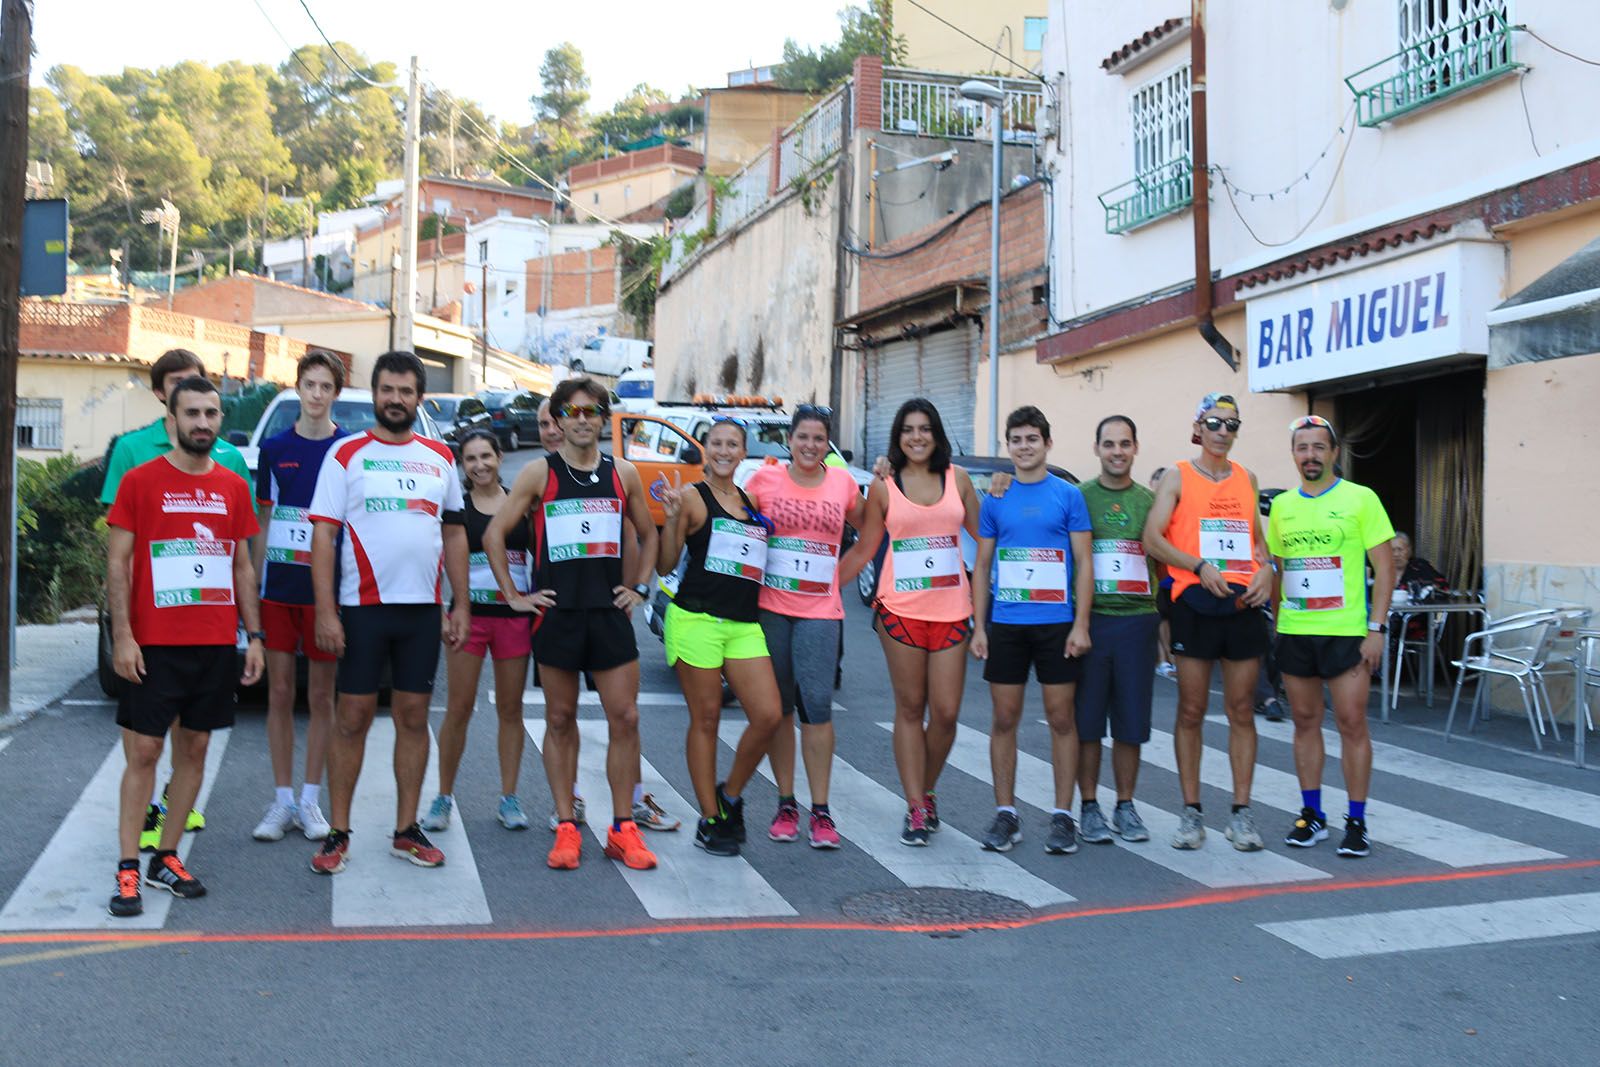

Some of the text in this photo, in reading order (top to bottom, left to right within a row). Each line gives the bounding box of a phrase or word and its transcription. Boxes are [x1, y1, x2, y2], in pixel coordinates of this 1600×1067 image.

[1258, 272, 1448, 368] BAR MIGUEL
[397, 478, 415, 491] 10
[581, 520, 590, 534] 8
[289, 529, 306, 542] 13
[740, 543, 749, 556] 5
[1218, 539, 1234, 551] 14
[795, 559, 809, 573] 11
[925, 556, 934, 568] 6
[1112, 560, 1120, 572] 3
[194, 563, 204, 578] 9
[1025, 568, 1034, 581] 7
[1301, 577, 1309, 590] 4
[158, 589, 192, 603] 2016
